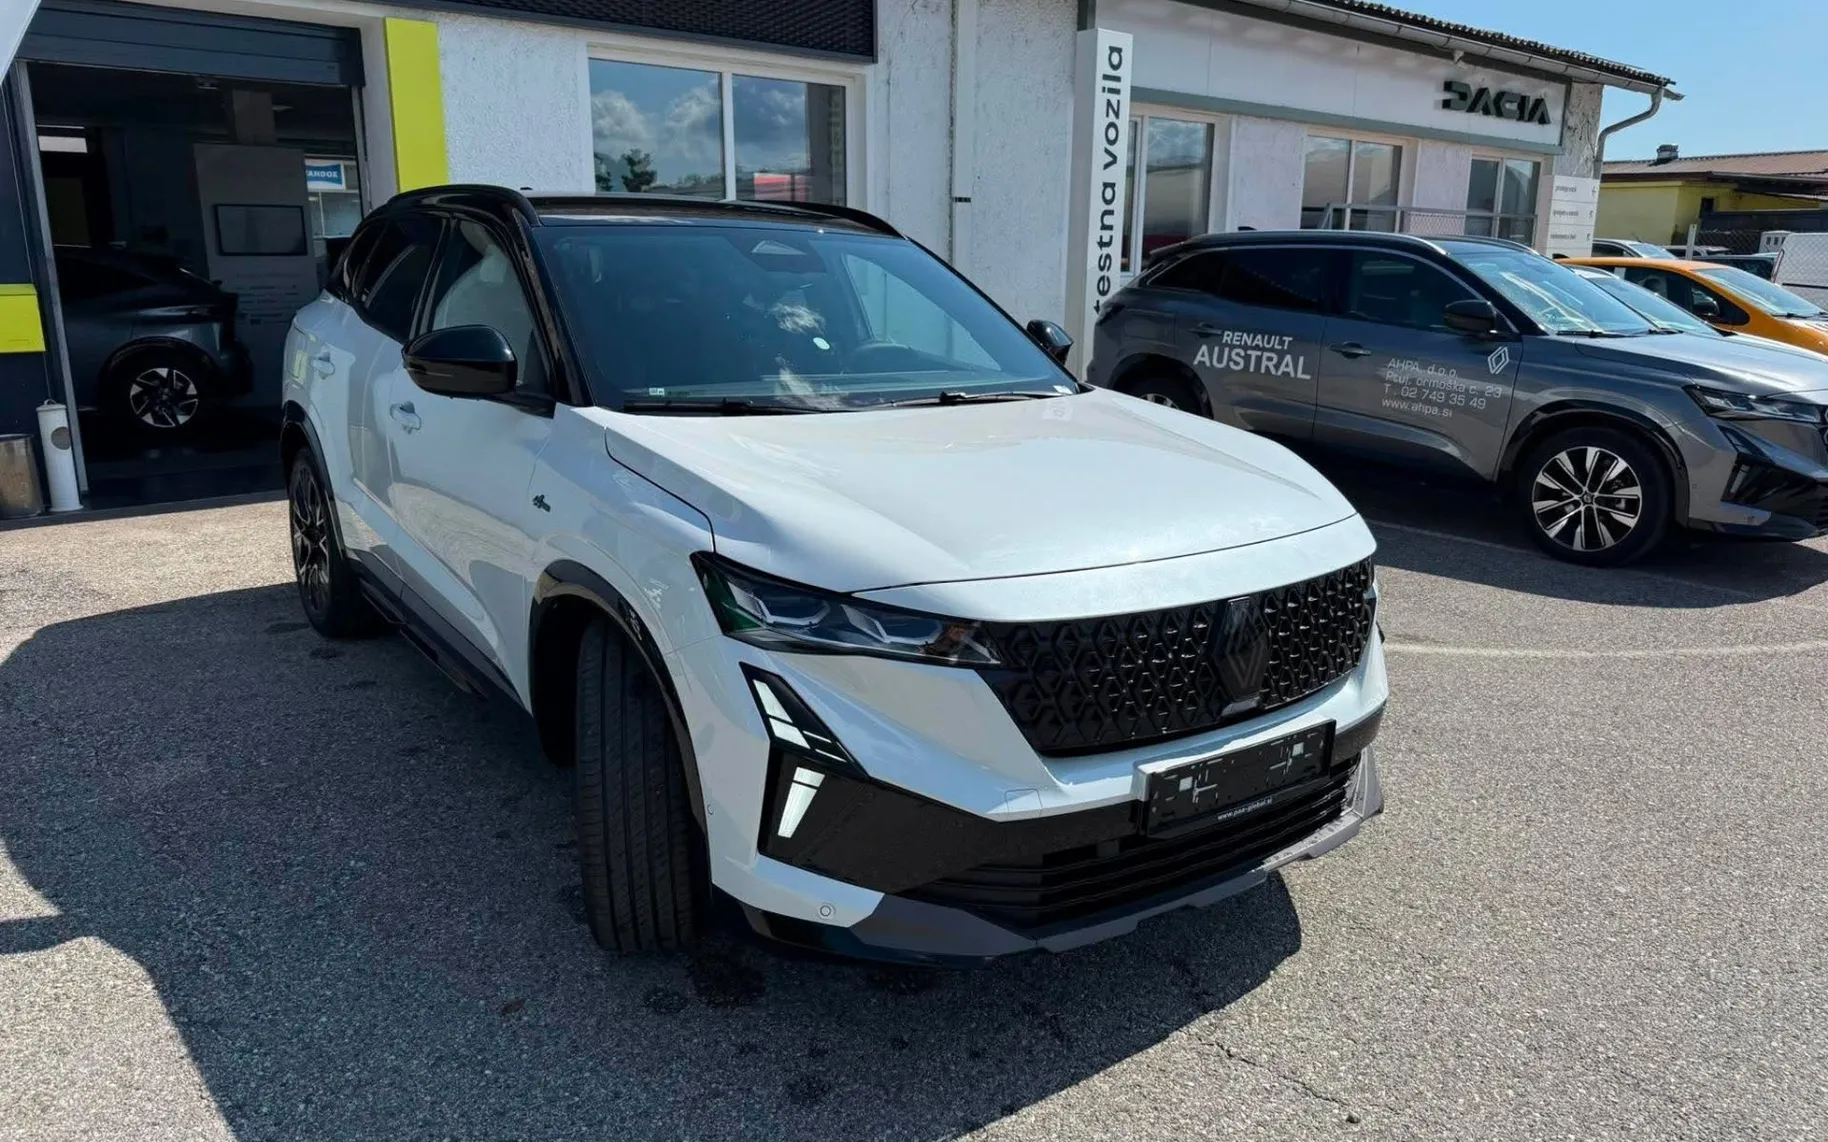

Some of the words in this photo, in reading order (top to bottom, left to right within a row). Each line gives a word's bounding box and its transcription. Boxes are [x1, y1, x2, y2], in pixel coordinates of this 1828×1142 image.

[1102, 46, 1123, 170] vozila
[1442, 81, 1551, 124] DACIA
[1222, 330, 1293, 350] RENAULT
[1193, 344, 1311, 380] AUSTRAL
[1400, 386, 1418, 399] 02
[1421, 389, 1445, 403] 749
[1448, 393, 1465, 406] 35
[1469, 398, 1486, 410] 49
[1416, 377, 1465, 393] ormoška
[1469, 385, 1479, 395] c.
[1484, 385, 1502, 398] 23
[1381, 398, 1453, 418] www.ahpa.si
